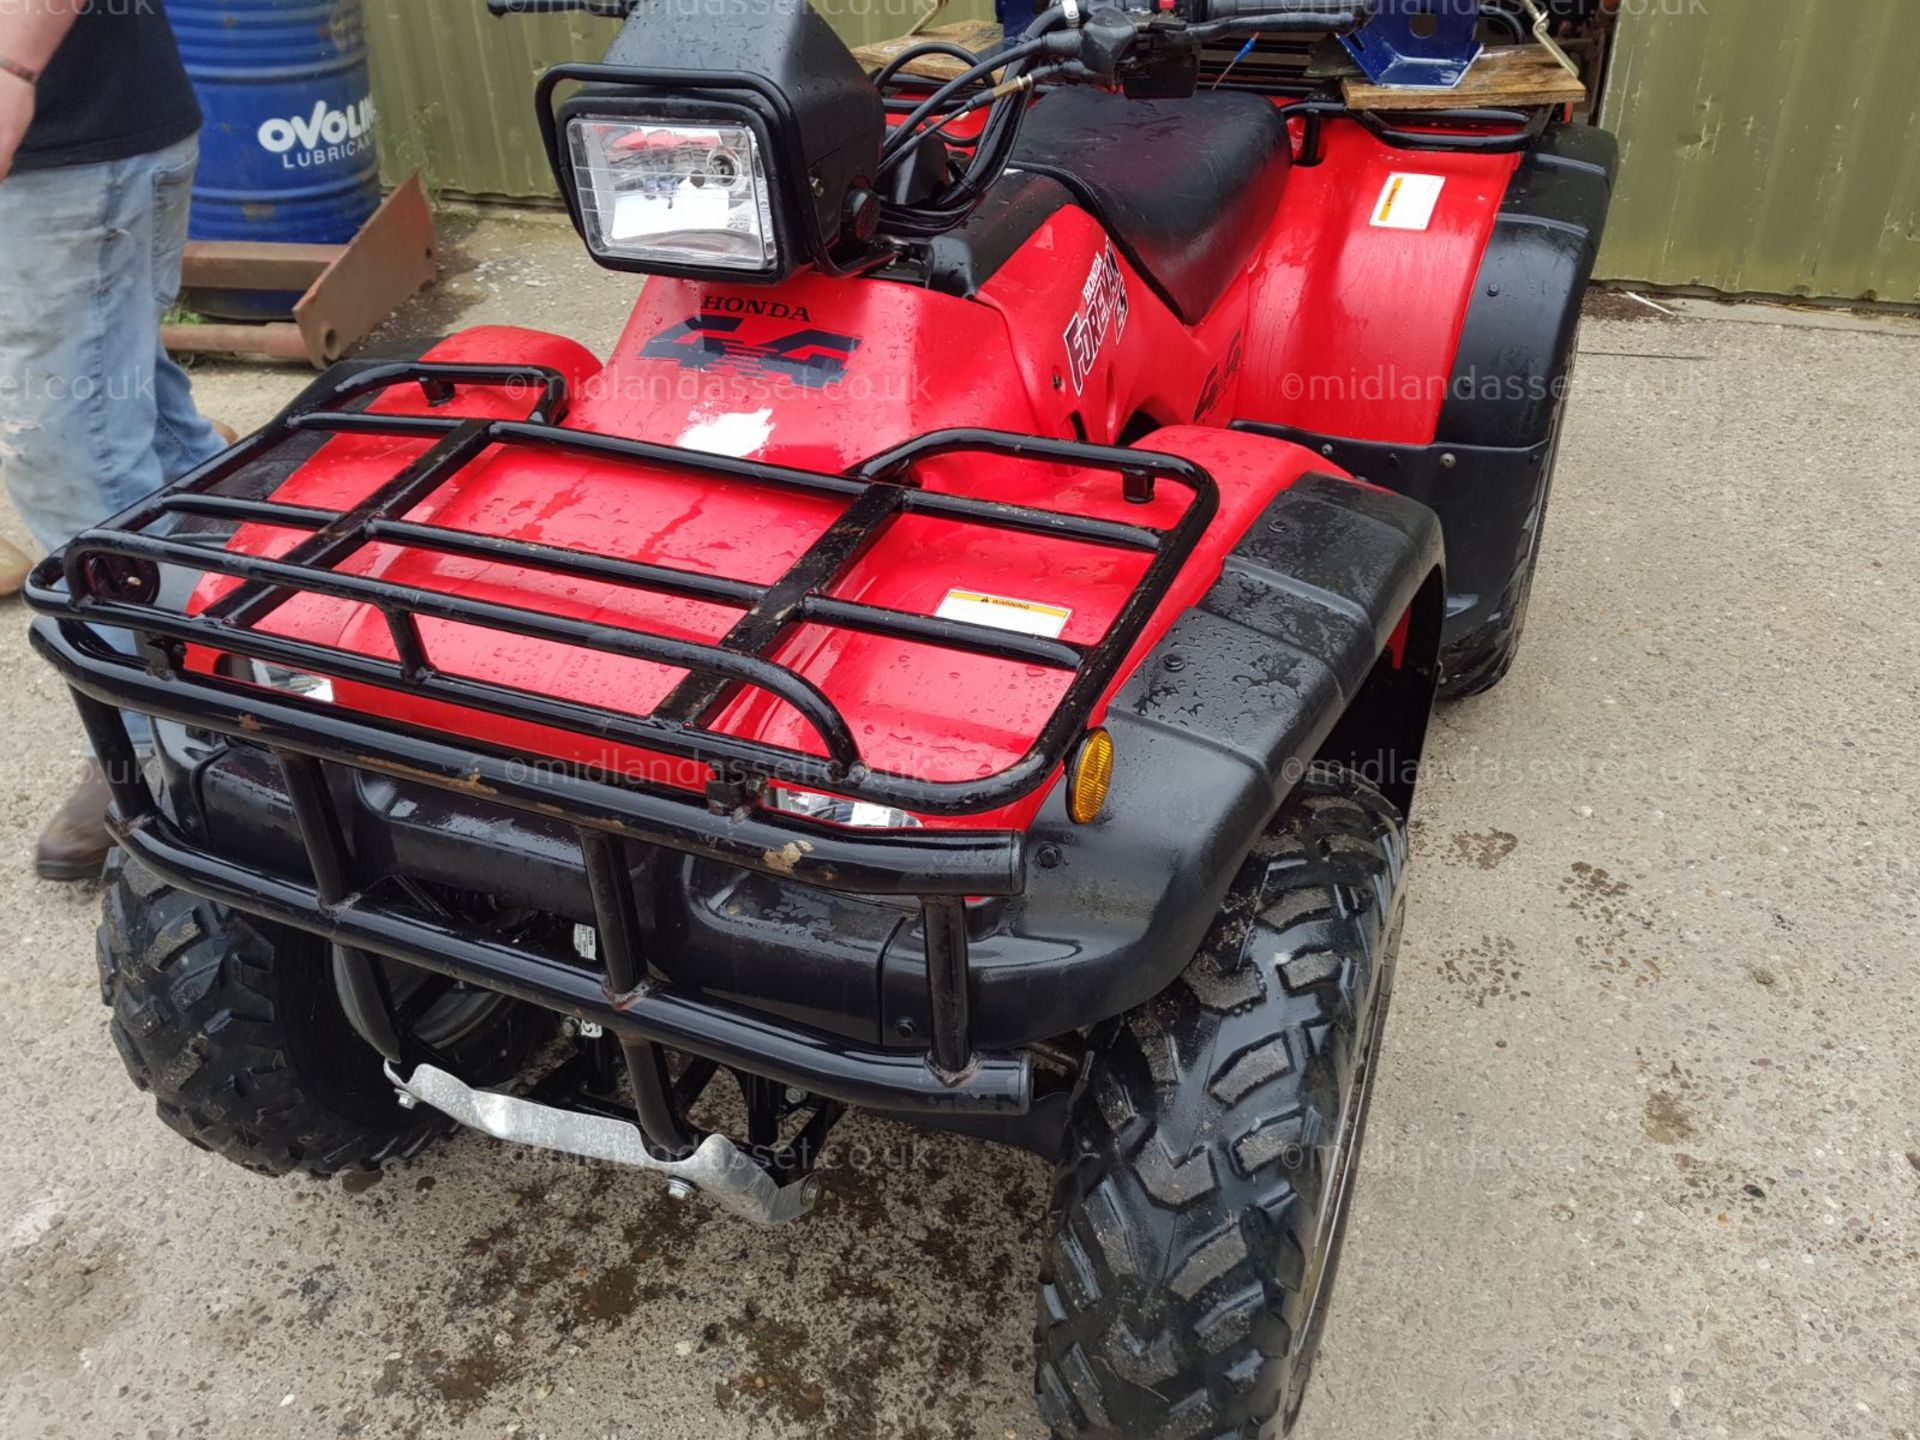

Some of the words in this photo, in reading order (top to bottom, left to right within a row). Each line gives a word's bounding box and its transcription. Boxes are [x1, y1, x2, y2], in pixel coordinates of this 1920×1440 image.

[1082, 251, 1103, 305] HONDA
[701, 295, 812, 323] HONDA
[1063, 235, 1120, 396] FOREMAN
